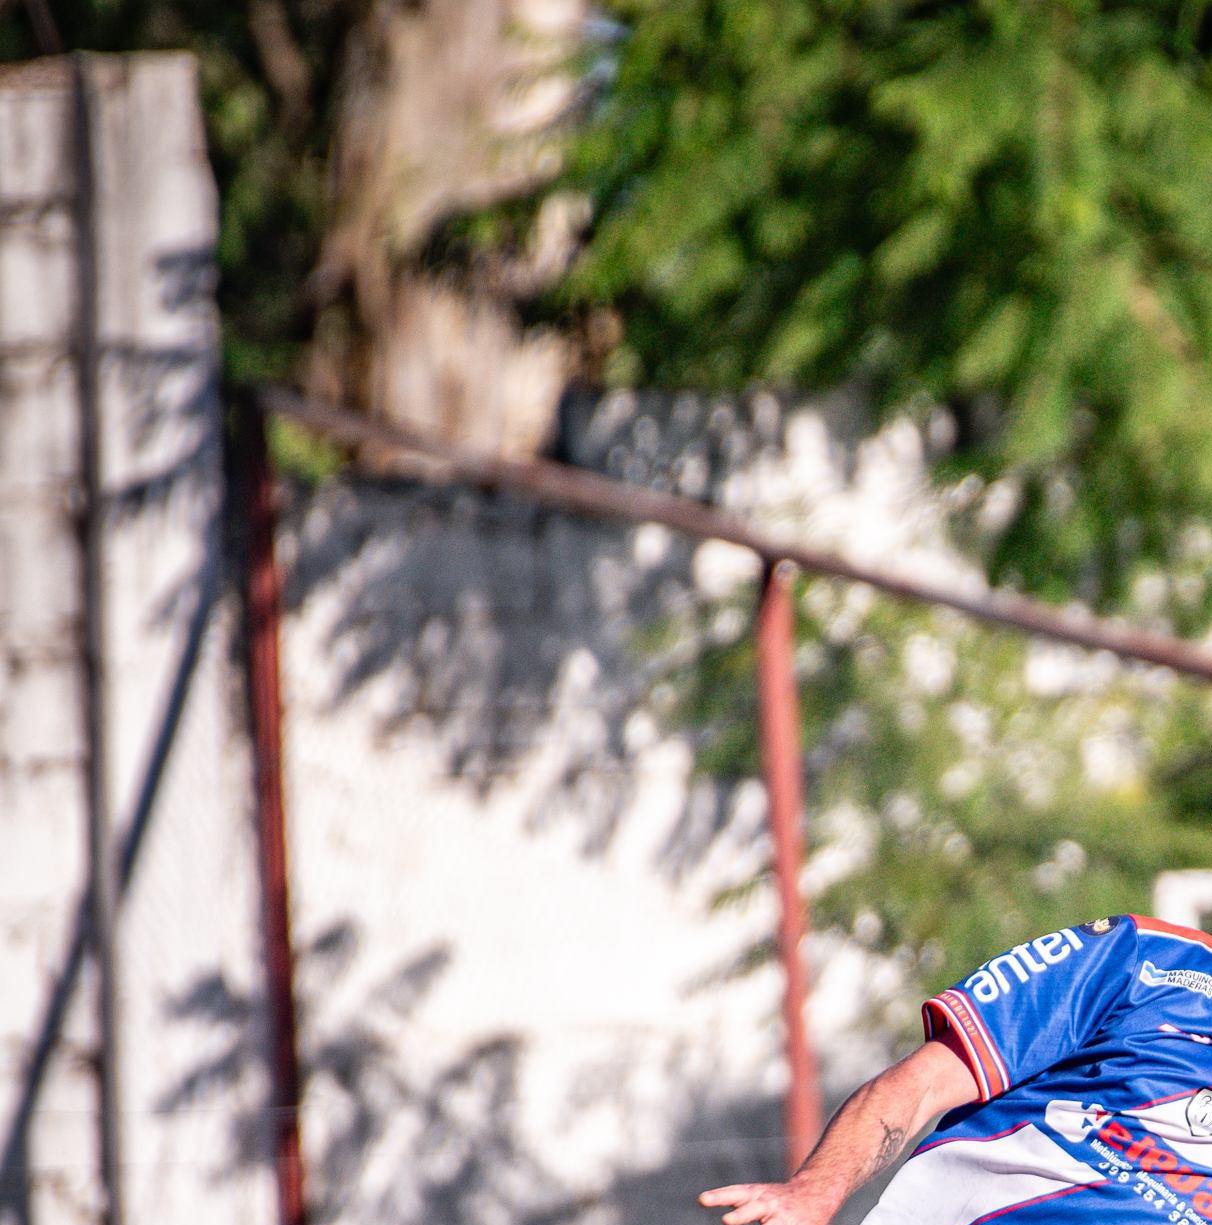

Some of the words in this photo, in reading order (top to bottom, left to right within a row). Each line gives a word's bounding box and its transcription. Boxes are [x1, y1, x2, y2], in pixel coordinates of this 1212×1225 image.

[1167, 977, 1212, 996] MADERAS
[961, 1015, 978, 1036] 1927
[1133, 1182, 1166, 1210] 154
[1135, 1170, 1178, 1206] Maquinaria
[1175, 1201, 1187, 1213] &
